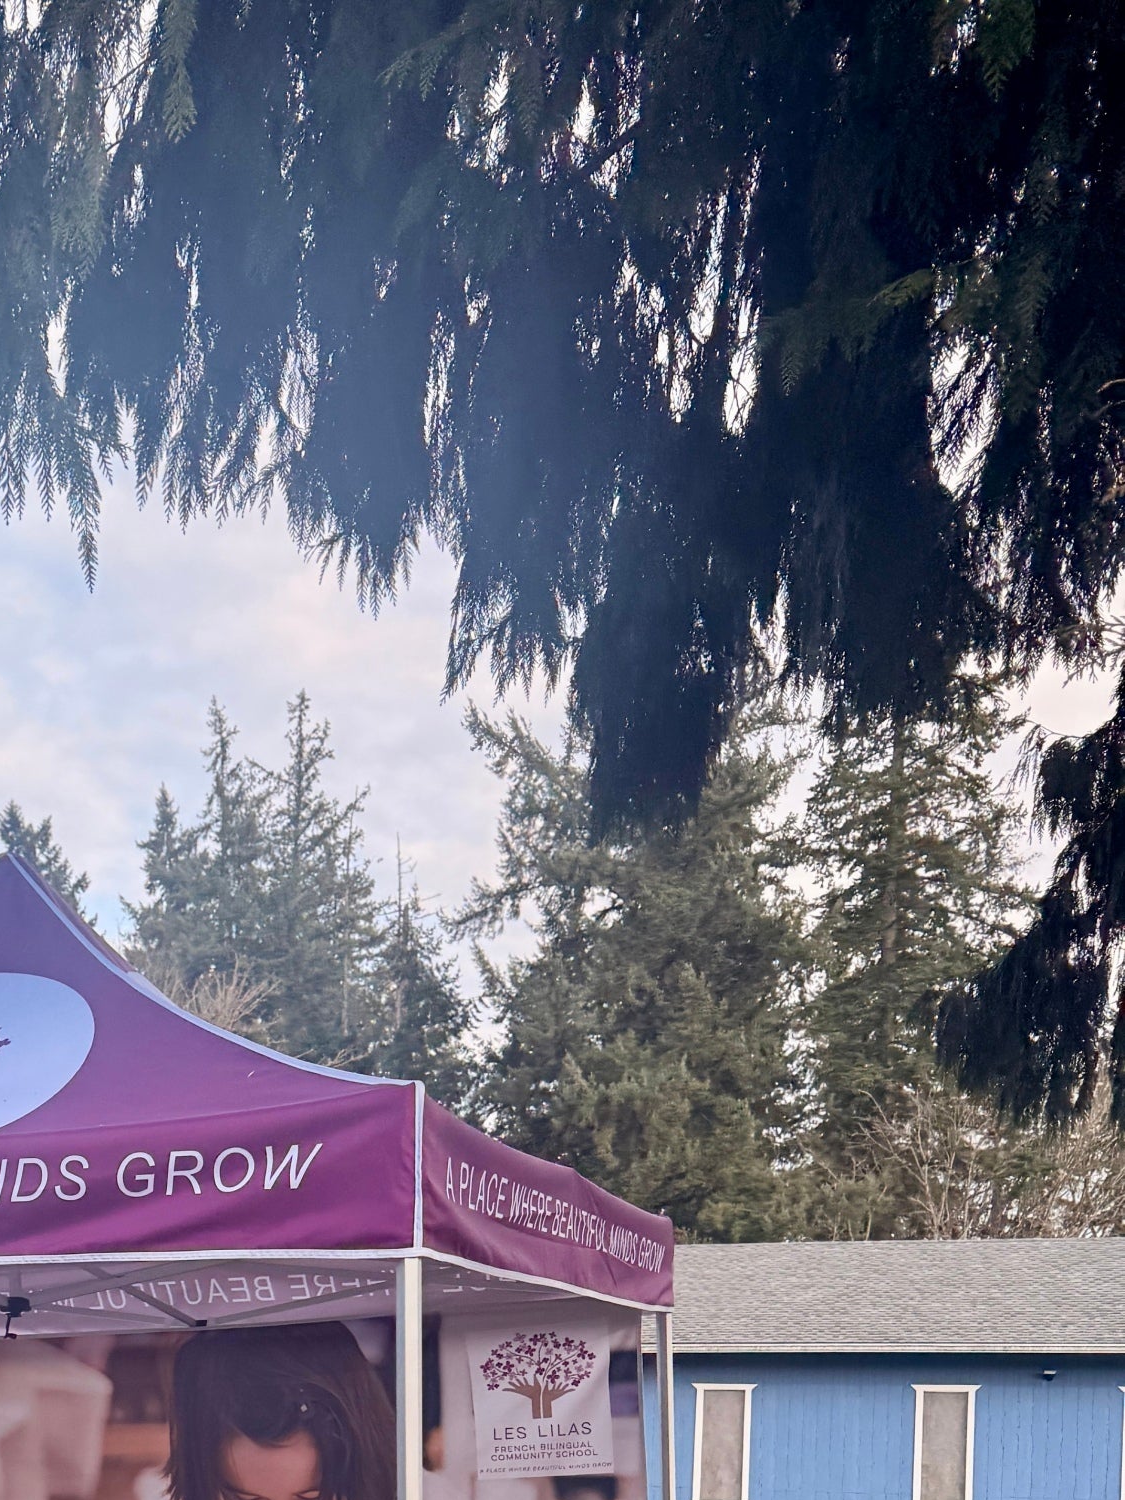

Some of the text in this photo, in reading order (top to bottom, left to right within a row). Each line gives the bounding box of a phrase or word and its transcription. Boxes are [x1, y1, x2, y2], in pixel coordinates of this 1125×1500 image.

[116, 1143, 323, 1198] GROW
[445, 1157, 666, 1274] A PLACE WHERE BEAUTIFUL MINDS GROW
[493, 1421, 592, 1441] LES LILAS
[490, 1449, 599, 1462] COMMUNITY SCHOOL
[494, 1441, 594, 1454] FRENCH BILINGUAL
